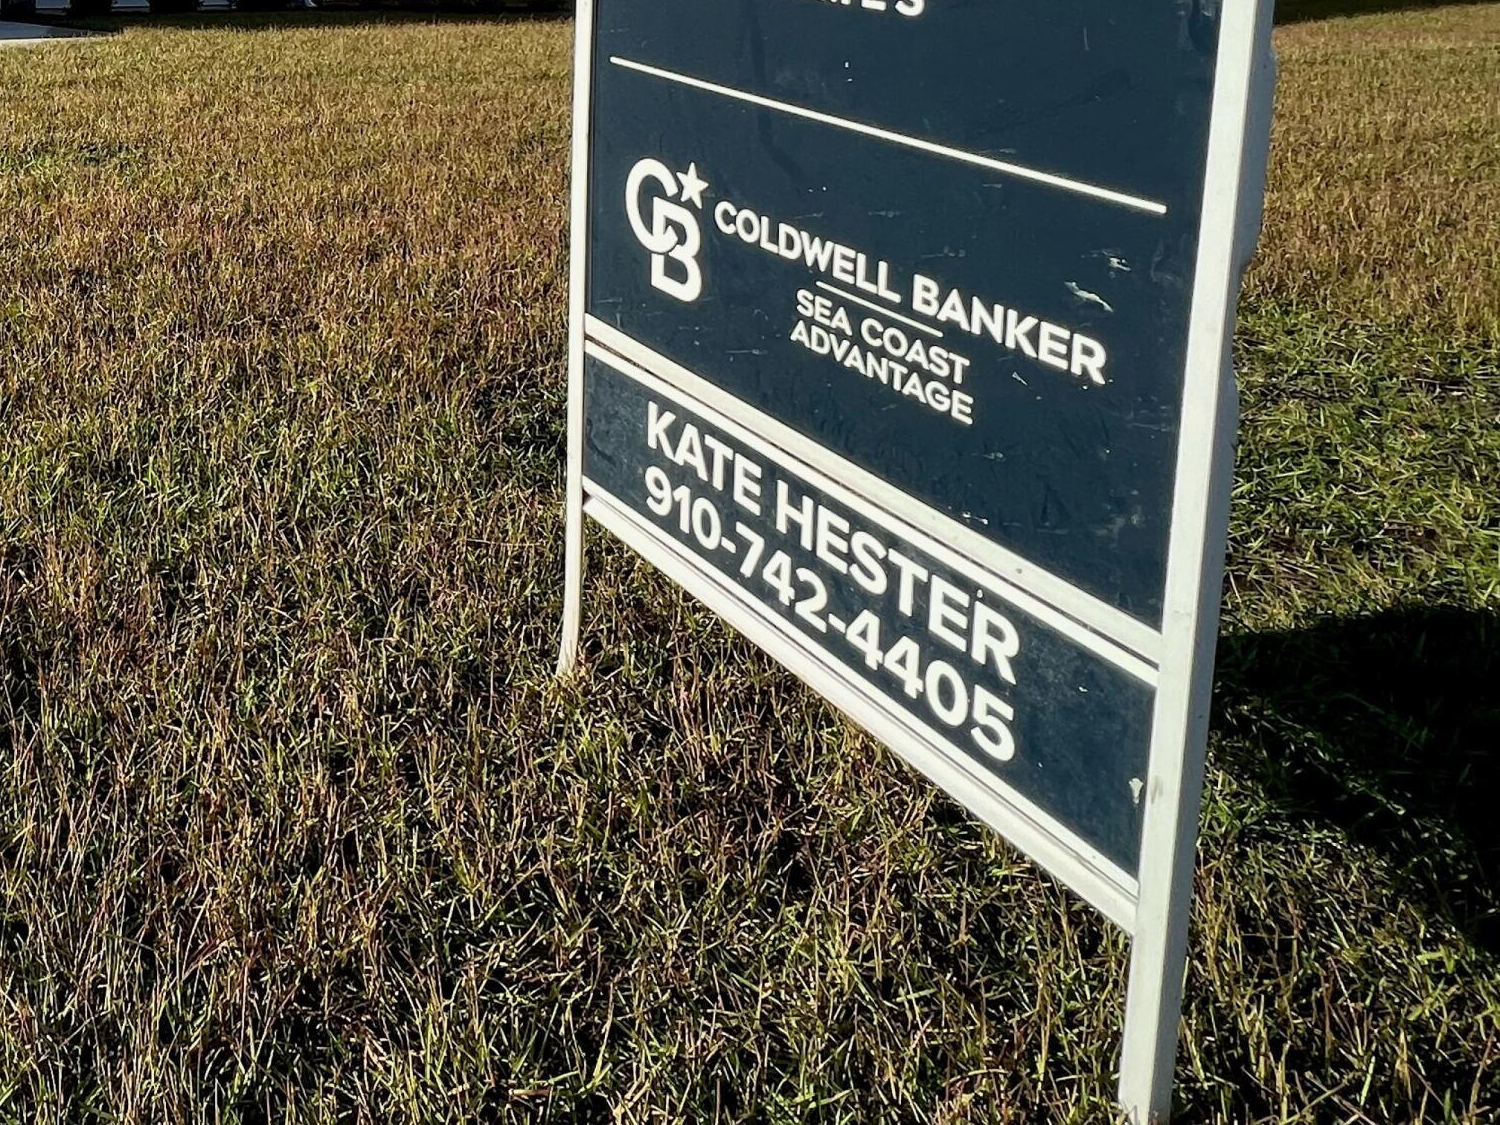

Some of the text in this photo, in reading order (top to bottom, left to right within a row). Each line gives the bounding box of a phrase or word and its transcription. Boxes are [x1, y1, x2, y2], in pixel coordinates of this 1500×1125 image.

[713, 199, 1108, 386] COLDWELL BANKER
[789, 318, 975, 426] ADVANTAGE
[795, 288, 972, 386] SEA COAST
[643, 464, 1017, 763] 910-742-4405
[646, 399, 1021, 686] KATE HESTER
